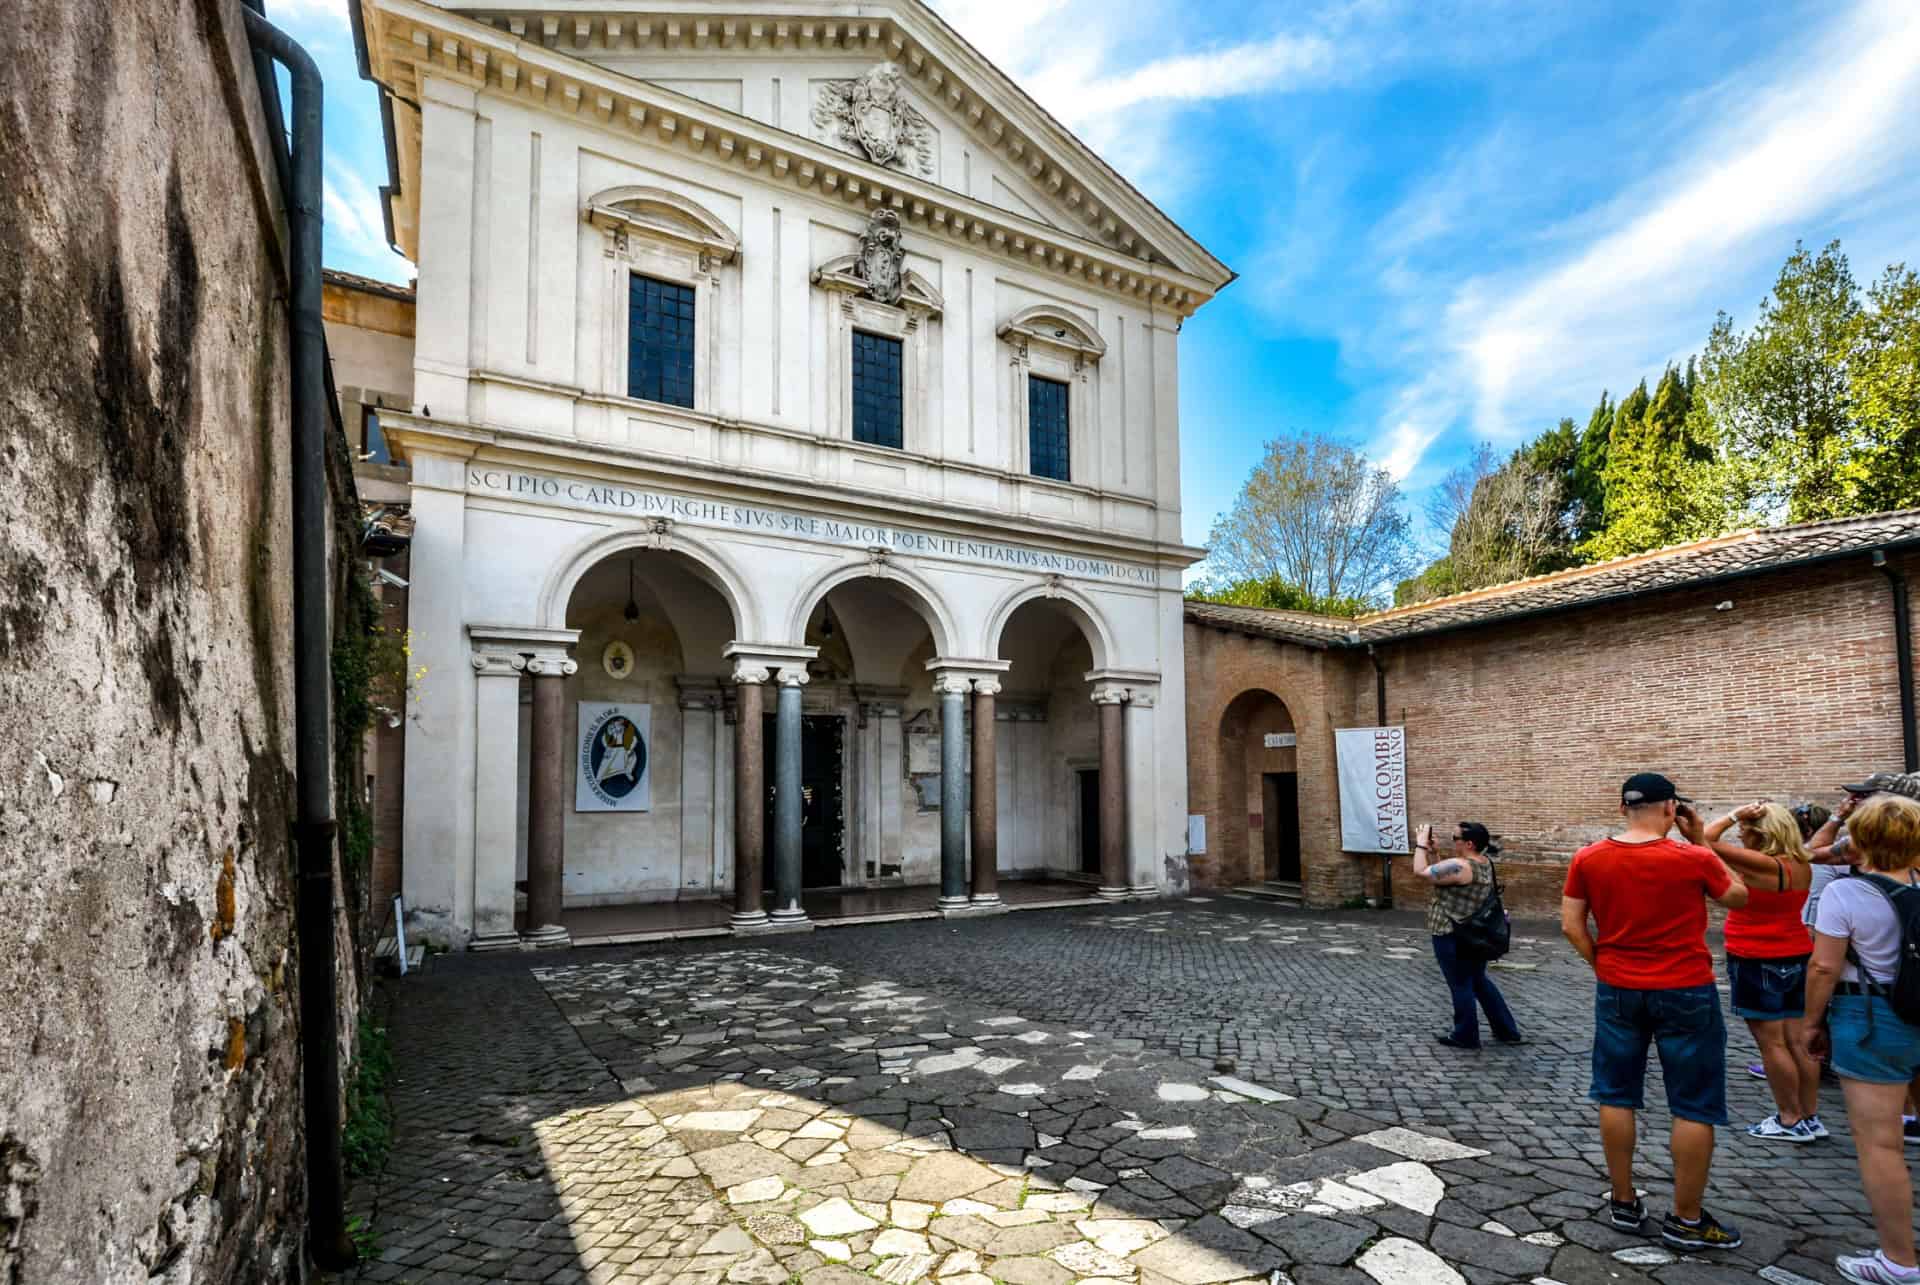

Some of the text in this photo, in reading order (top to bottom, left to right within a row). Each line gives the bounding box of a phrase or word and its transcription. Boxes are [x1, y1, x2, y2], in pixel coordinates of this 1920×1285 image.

[470, 471, 559, 497] SCIPIO
[568, 484, 635, 508] CARD
[1375, 729, 1393, 850] CATACOMBE
[1391, 729, 1406, 851] SAN SEBASTIANO
